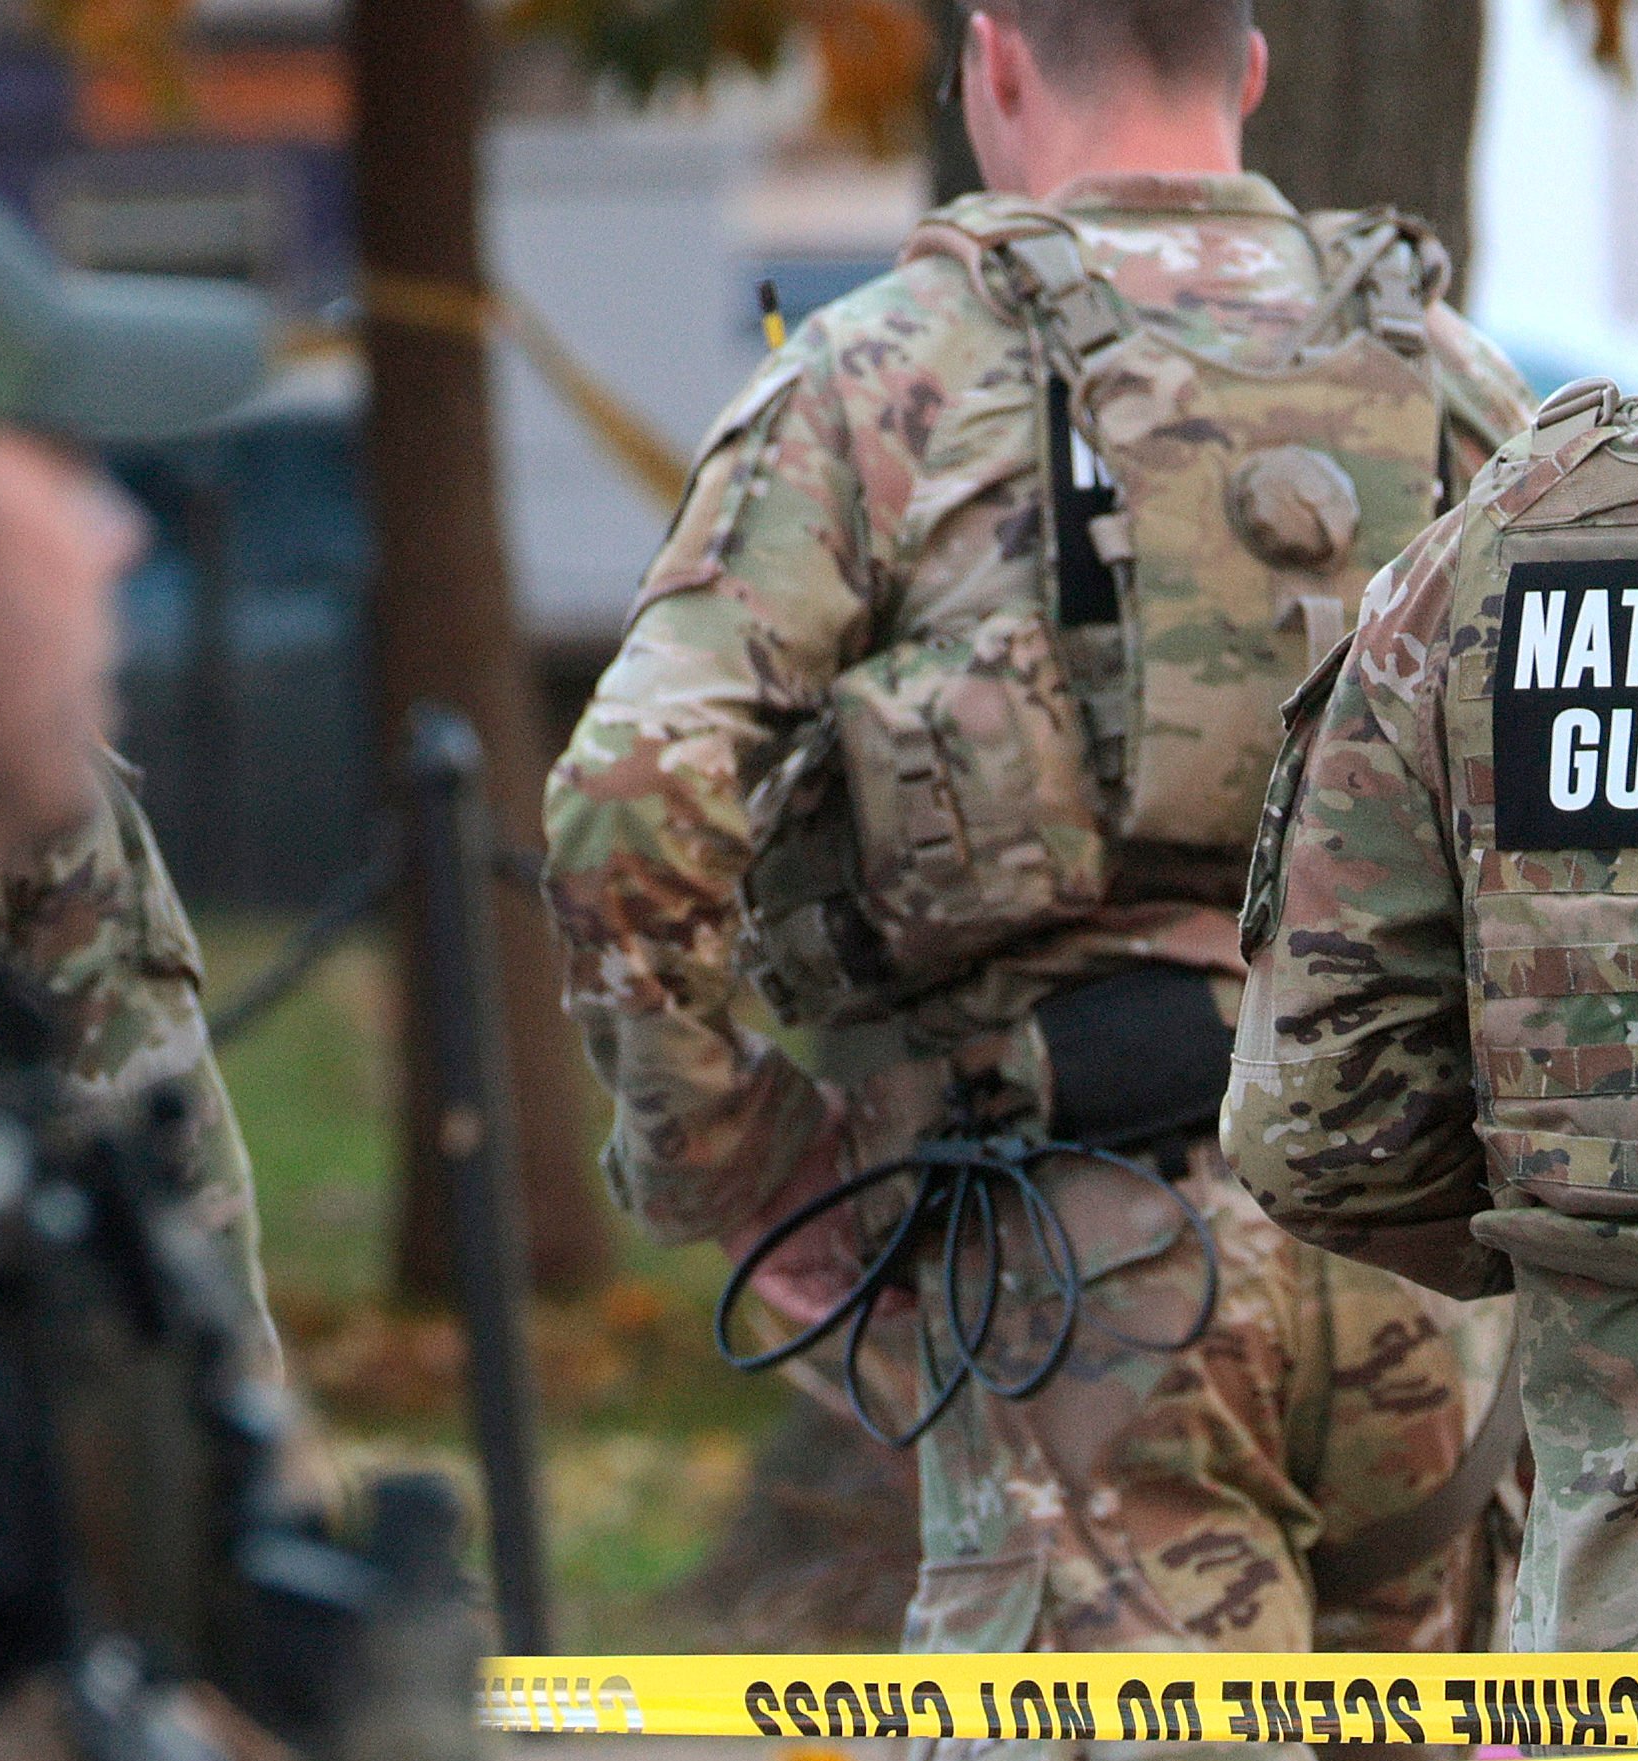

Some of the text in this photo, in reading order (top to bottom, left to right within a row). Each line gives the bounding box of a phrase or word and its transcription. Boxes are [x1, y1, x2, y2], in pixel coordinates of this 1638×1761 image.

[745, 1680, 954, 1738] CROSS
[980, 1679, 1096, 1740] NOT
[1117, 1679, 1203, 1741] DO
[1223, 1678, 1425, 1744] SCENE
